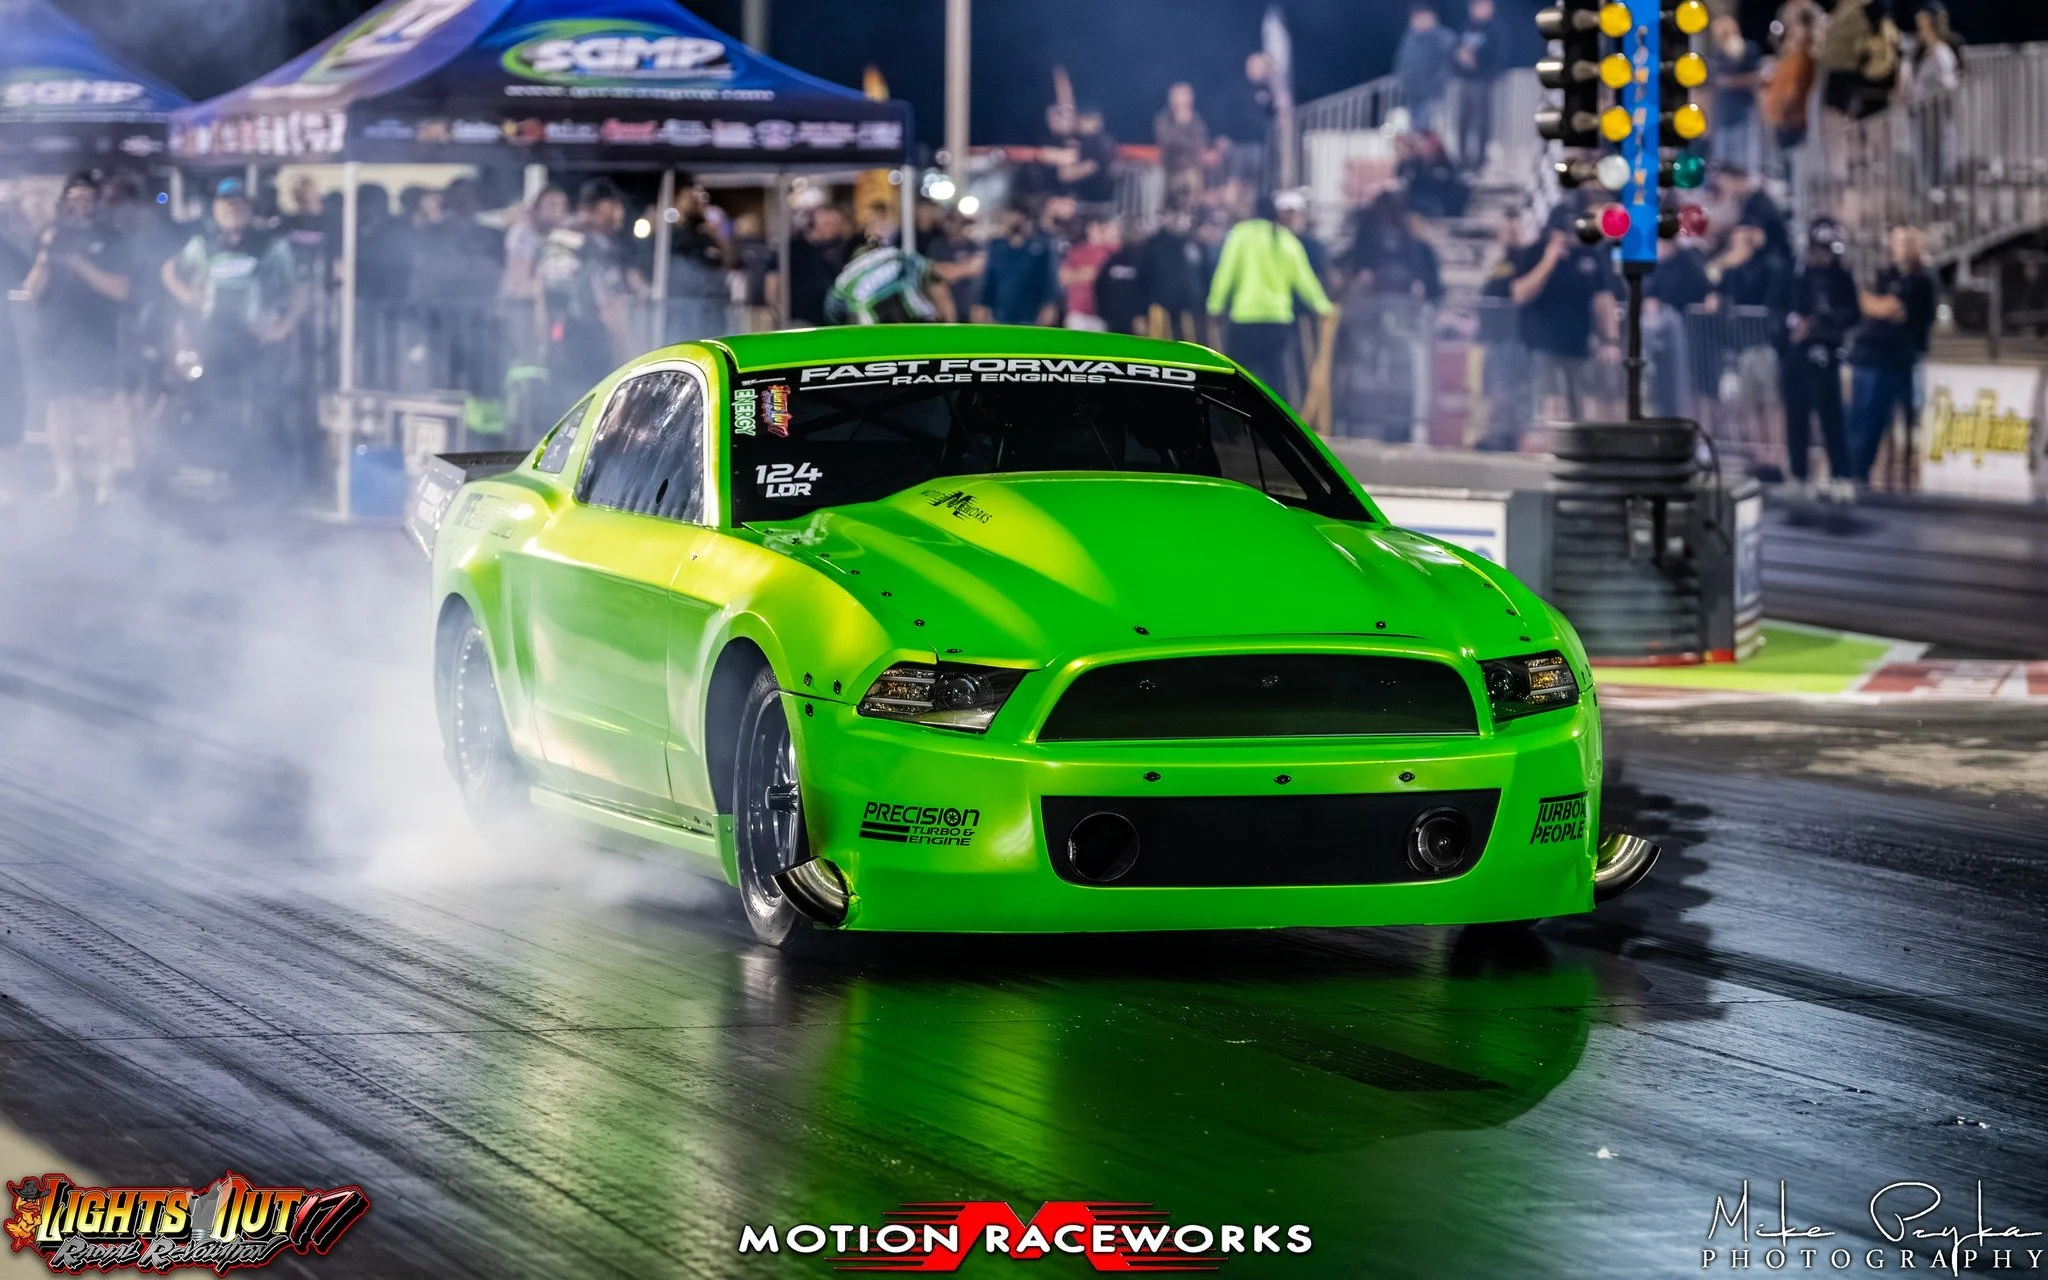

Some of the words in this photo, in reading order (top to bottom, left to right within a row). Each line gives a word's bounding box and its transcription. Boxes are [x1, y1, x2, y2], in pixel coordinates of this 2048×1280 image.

[533, 36, 726, 72] SGMP
[801, 360, 930, 383] FAST
[940, 358, 1197, 383] FORWARD
[892, 372, 972, 386] RACE
[981, 372, 1107, 385] ENGINES
[732, 388, 758, 436] ENERGY
[755, 462, 823, 484] 124
[863, 801, 981, 827] PRECISION
[909, 836, 971, 847] ENGINE
[912, 825, 961, 837] TURBO
[963, 828, 976, 837] &
[1530, 819, 1585, 844] PEOPLE
